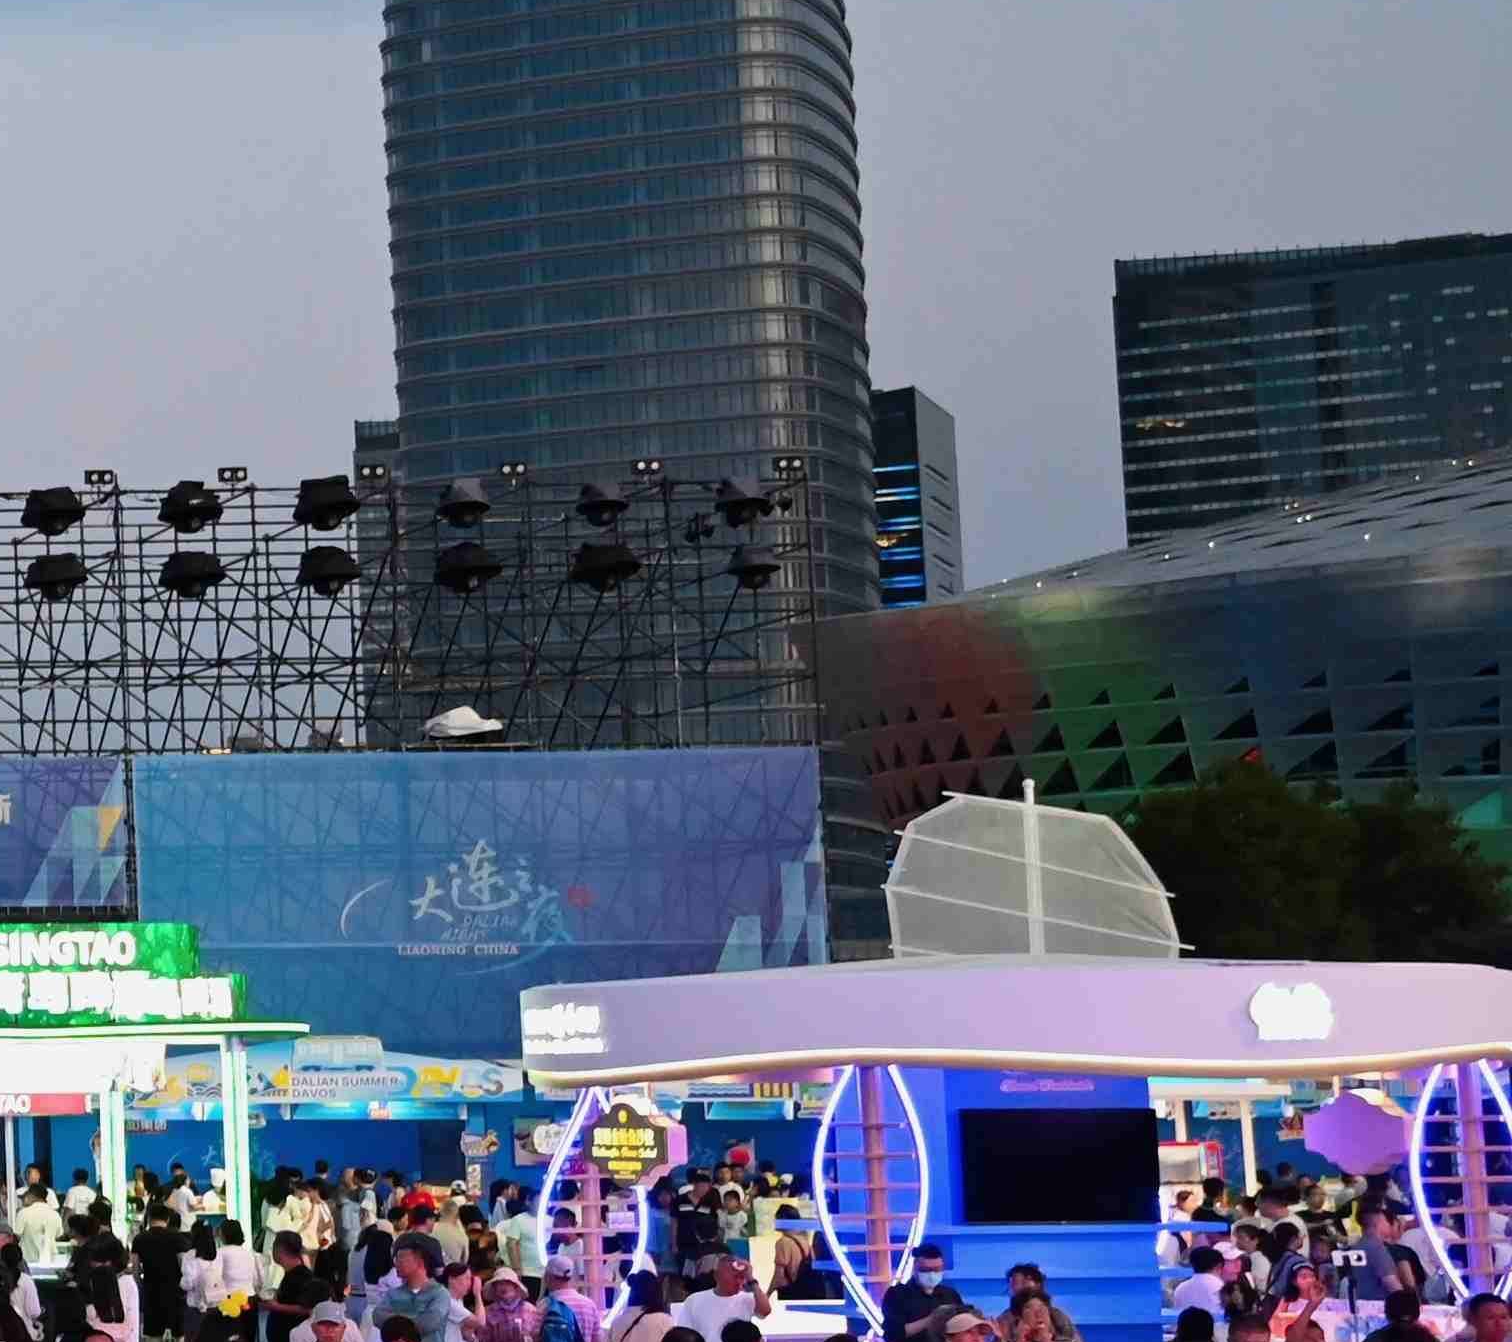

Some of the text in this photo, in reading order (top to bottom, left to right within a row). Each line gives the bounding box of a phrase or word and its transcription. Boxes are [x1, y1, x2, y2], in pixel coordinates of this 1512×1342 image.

[473, 943, 521, 956] CHINA
[291, 1075, 400, 1088] DALIAN SUMMER
[291, 1088, 337, 1099] DAVOS
